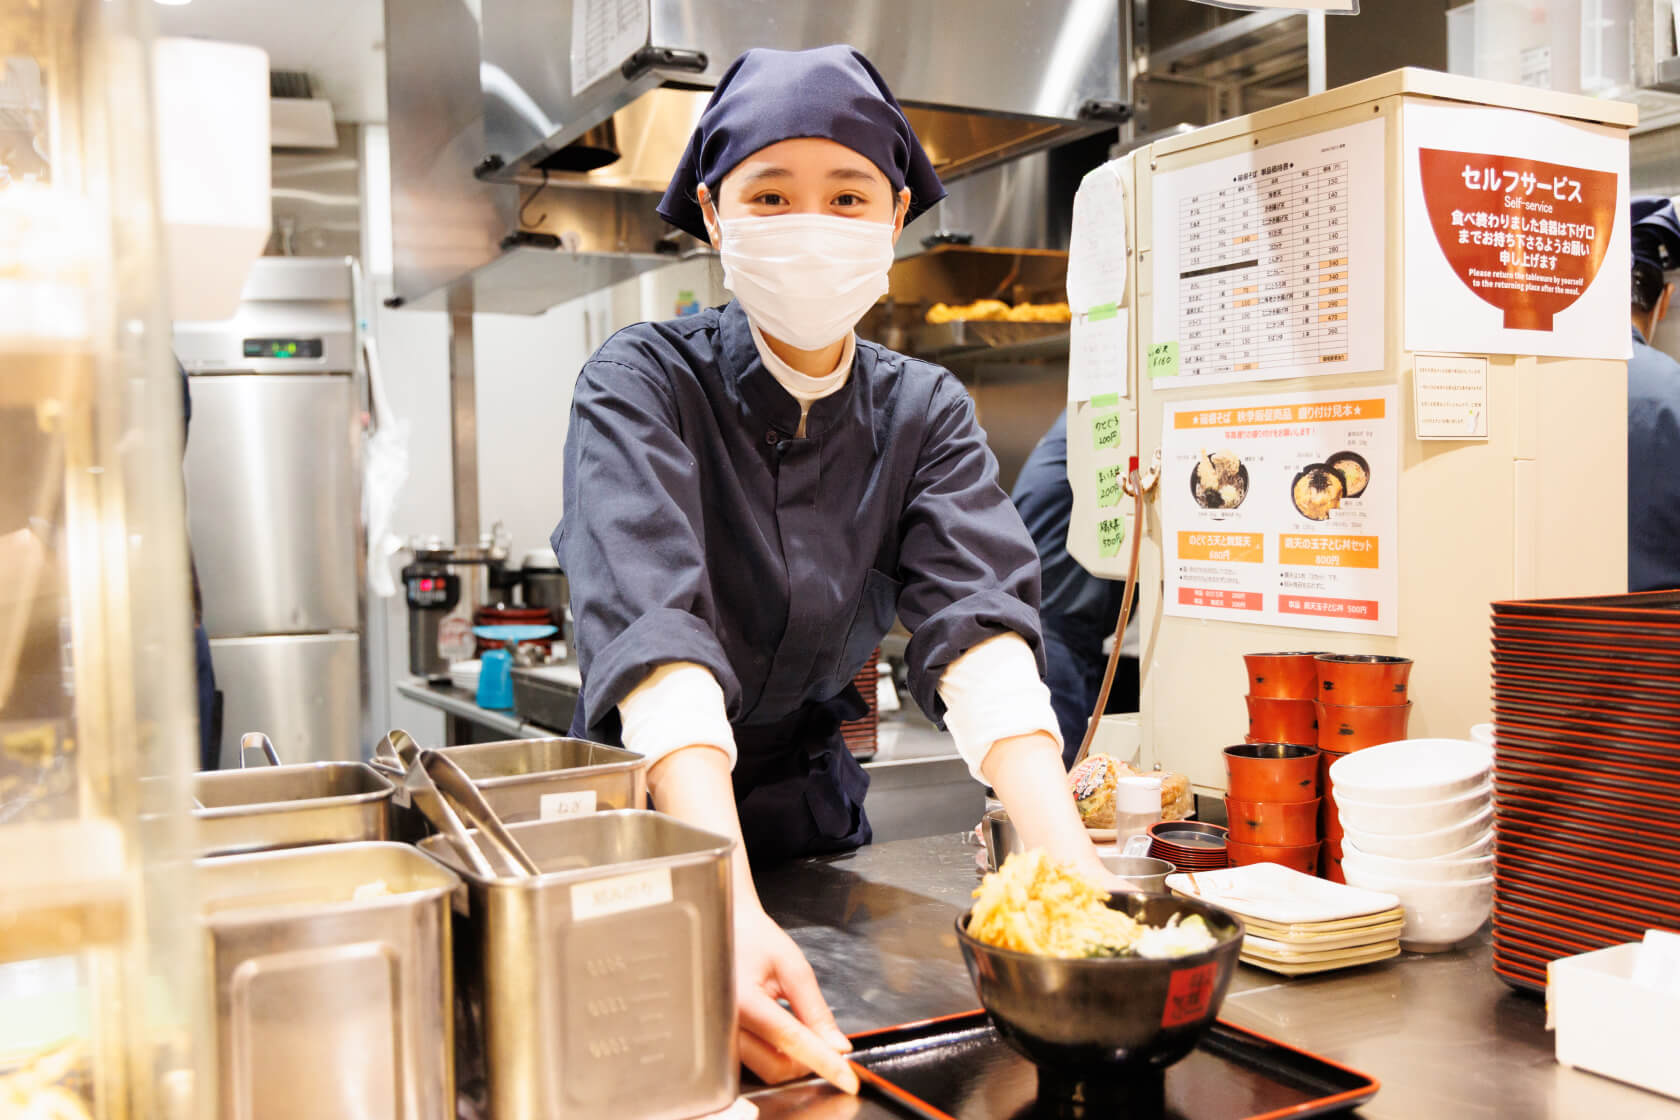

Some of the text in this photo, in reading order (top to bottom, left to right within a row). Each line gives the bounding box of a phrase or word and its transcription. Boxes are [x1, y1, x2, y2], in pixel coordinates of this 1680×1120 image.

[1462, 164, 1582, 202] セルフサービス
[1504, 196, 1552, 213] Self-service
[1451, 210, 1594, 240] 食べ終わりました食器は下げ口
[1458, 230, 1590, 256] までお持ち下さるようお願い
[1500, 250, 1558, 270] 申し上げます
[1468, 268, 1492, 278] Please
[1493, 270, 1513, 280] return
[1514, 272, 1524, 280] the
[1554, 276, 1560, 285] by
[1561, 277, 1584, 286] yourself
[1482, 280, 1493, 288] the
[1494, 281, 1524, 291] returning
[1555, 285, 1564, 294] the
